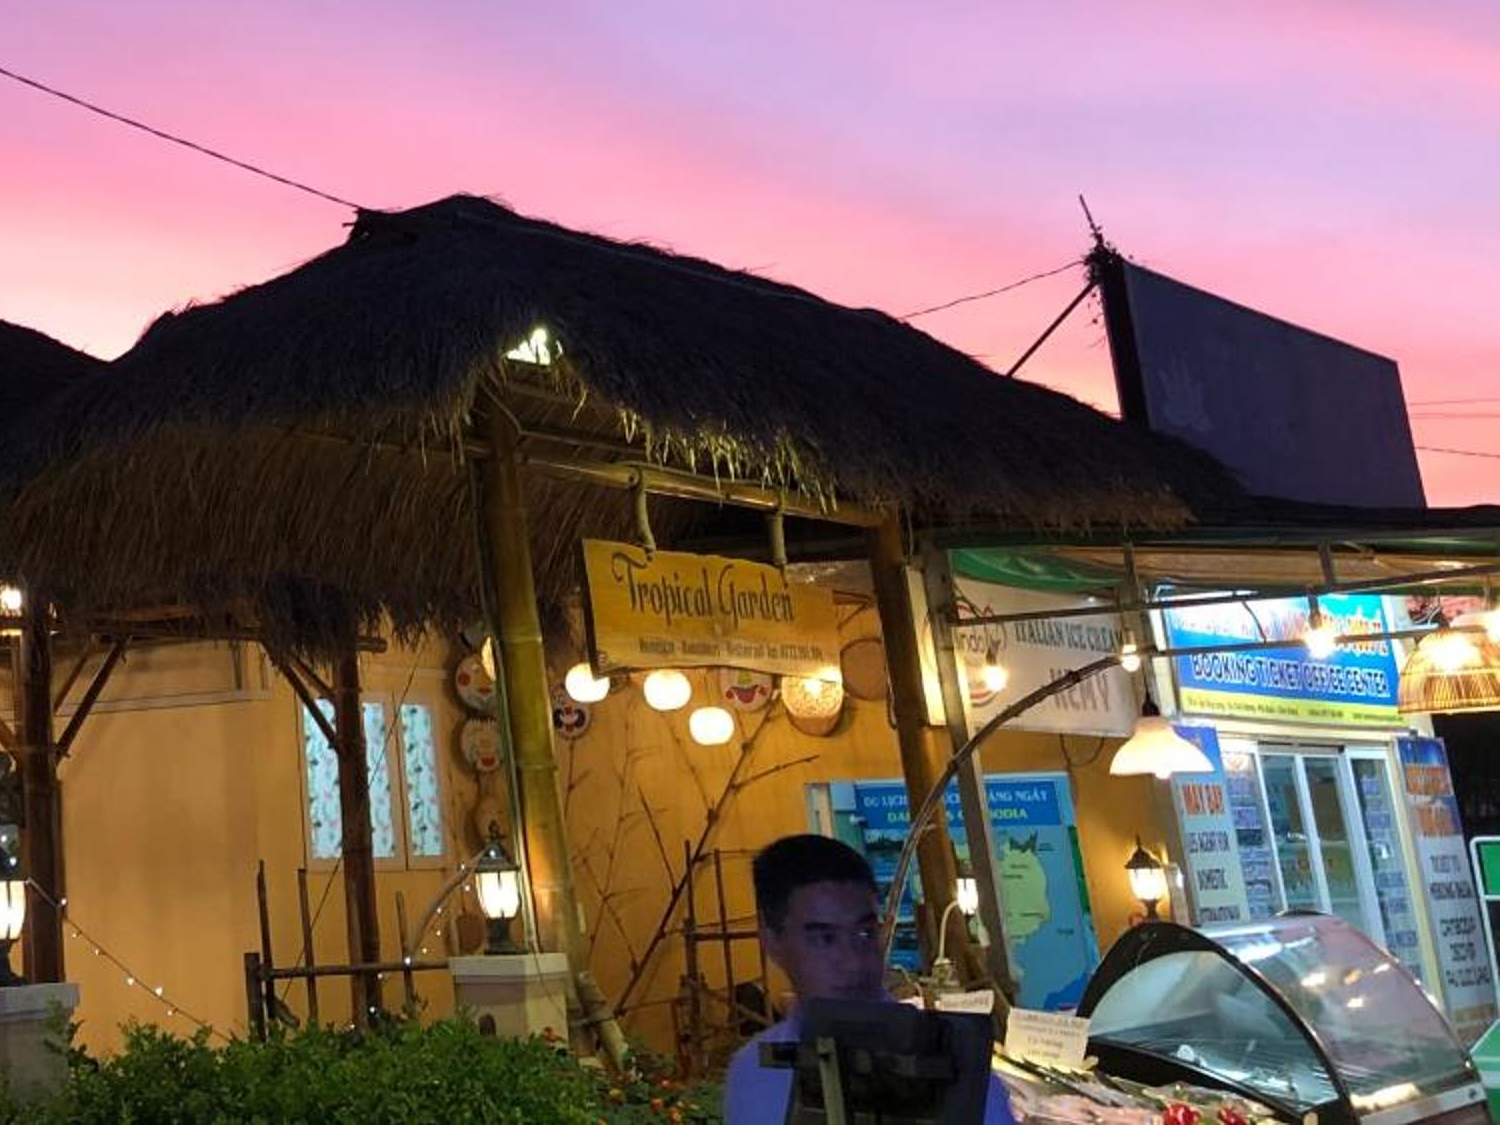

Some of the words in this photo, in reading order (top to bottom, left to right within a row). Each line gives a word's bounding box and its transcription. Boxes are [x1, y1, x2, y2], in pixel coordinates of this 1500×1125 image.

[612, 552, 713, 626] Tropical
[717, 564, 794, 629] Garden
[1014, 621, 1065, 647] ITALIAN
[1191, 653, 1257, 684] BOOKING
[1256, 657, 1301, 690] TICKET
[1303, 662, 1345, 694] OFFICE
[1345, 667, 1390, 697] CENTER
